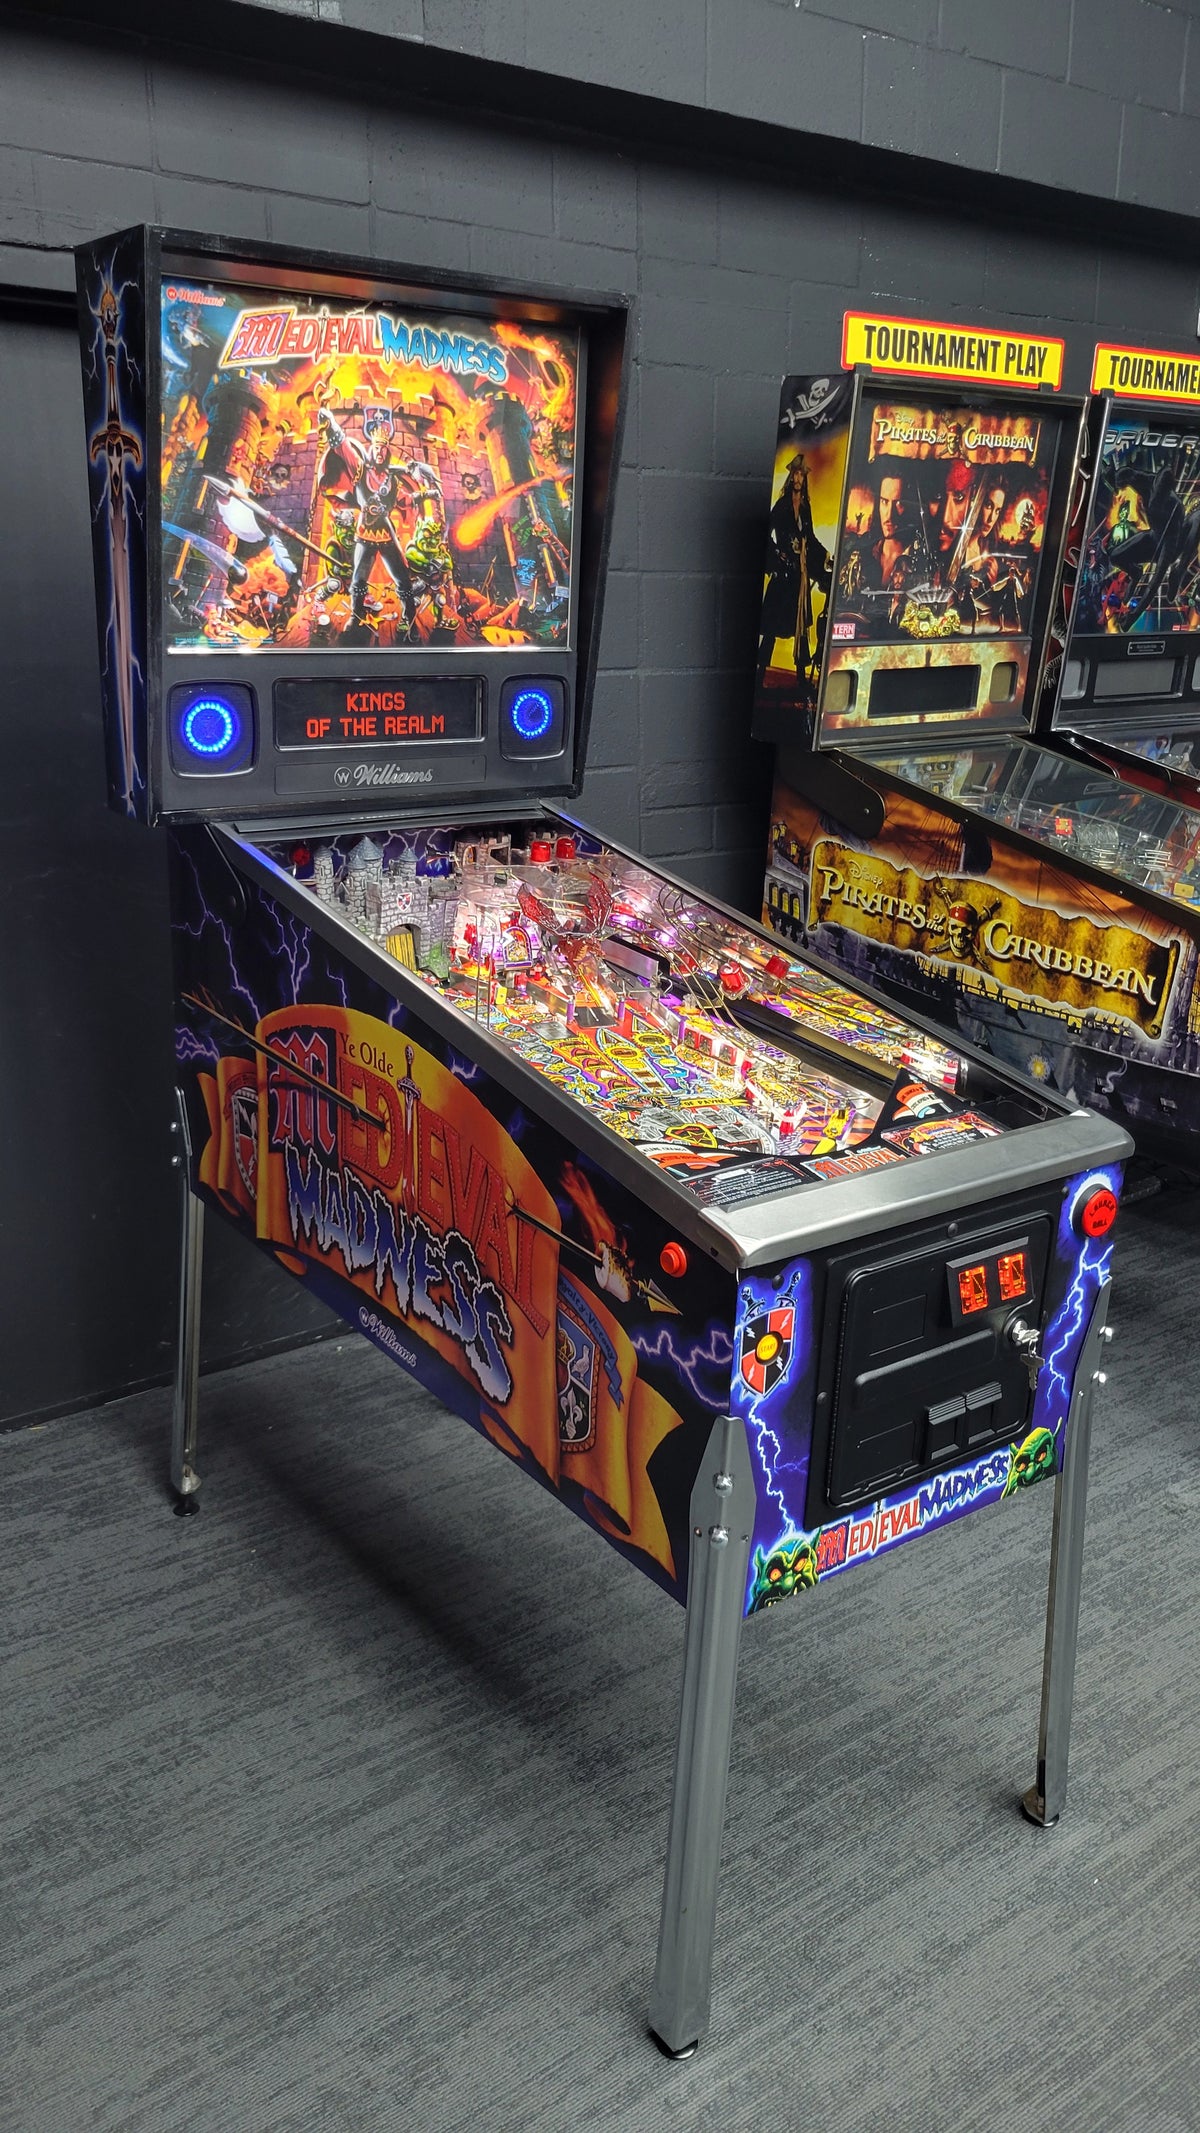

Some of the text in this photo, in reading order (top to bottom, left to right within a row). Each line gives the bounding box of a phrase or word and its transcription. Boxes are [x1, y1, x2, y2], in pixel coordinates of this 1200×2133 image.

[179, 287, 225, 307] Williams
[228, 311, 506, 383] MEDIEVAL MADNESS
[864, 325, 1048, 378] TOURNAMENT PLAY
[1110, 355, 1200, 394] TOURNAME
[876, 419, 937, 444] PIRATES
[964, 427, 1034, 452] CARIBBEAN
[832, 623, 854, 635] TERN
[346, 691, 405, 713] KINGS
[306, 714, 445, 739] OF THE REALM
[353, 763, 433, 787] Williams
[849, 859, 884, 889] Disney
[817, 864, 1157, 1005] PIRATES of the CARIBBEAN
[338, 1031, 394, 1078] Ye Olde
[268, 1031, 551, 1339] MEDIEVAL
[1093, 1219, 1108, 1229] BALL
[284, 1137, 513, 1403] MADNESS
[368, 1313, 417, 1368] Williams
[816, 1453, 1010, 1571] MEDIEVAL MADNESS
